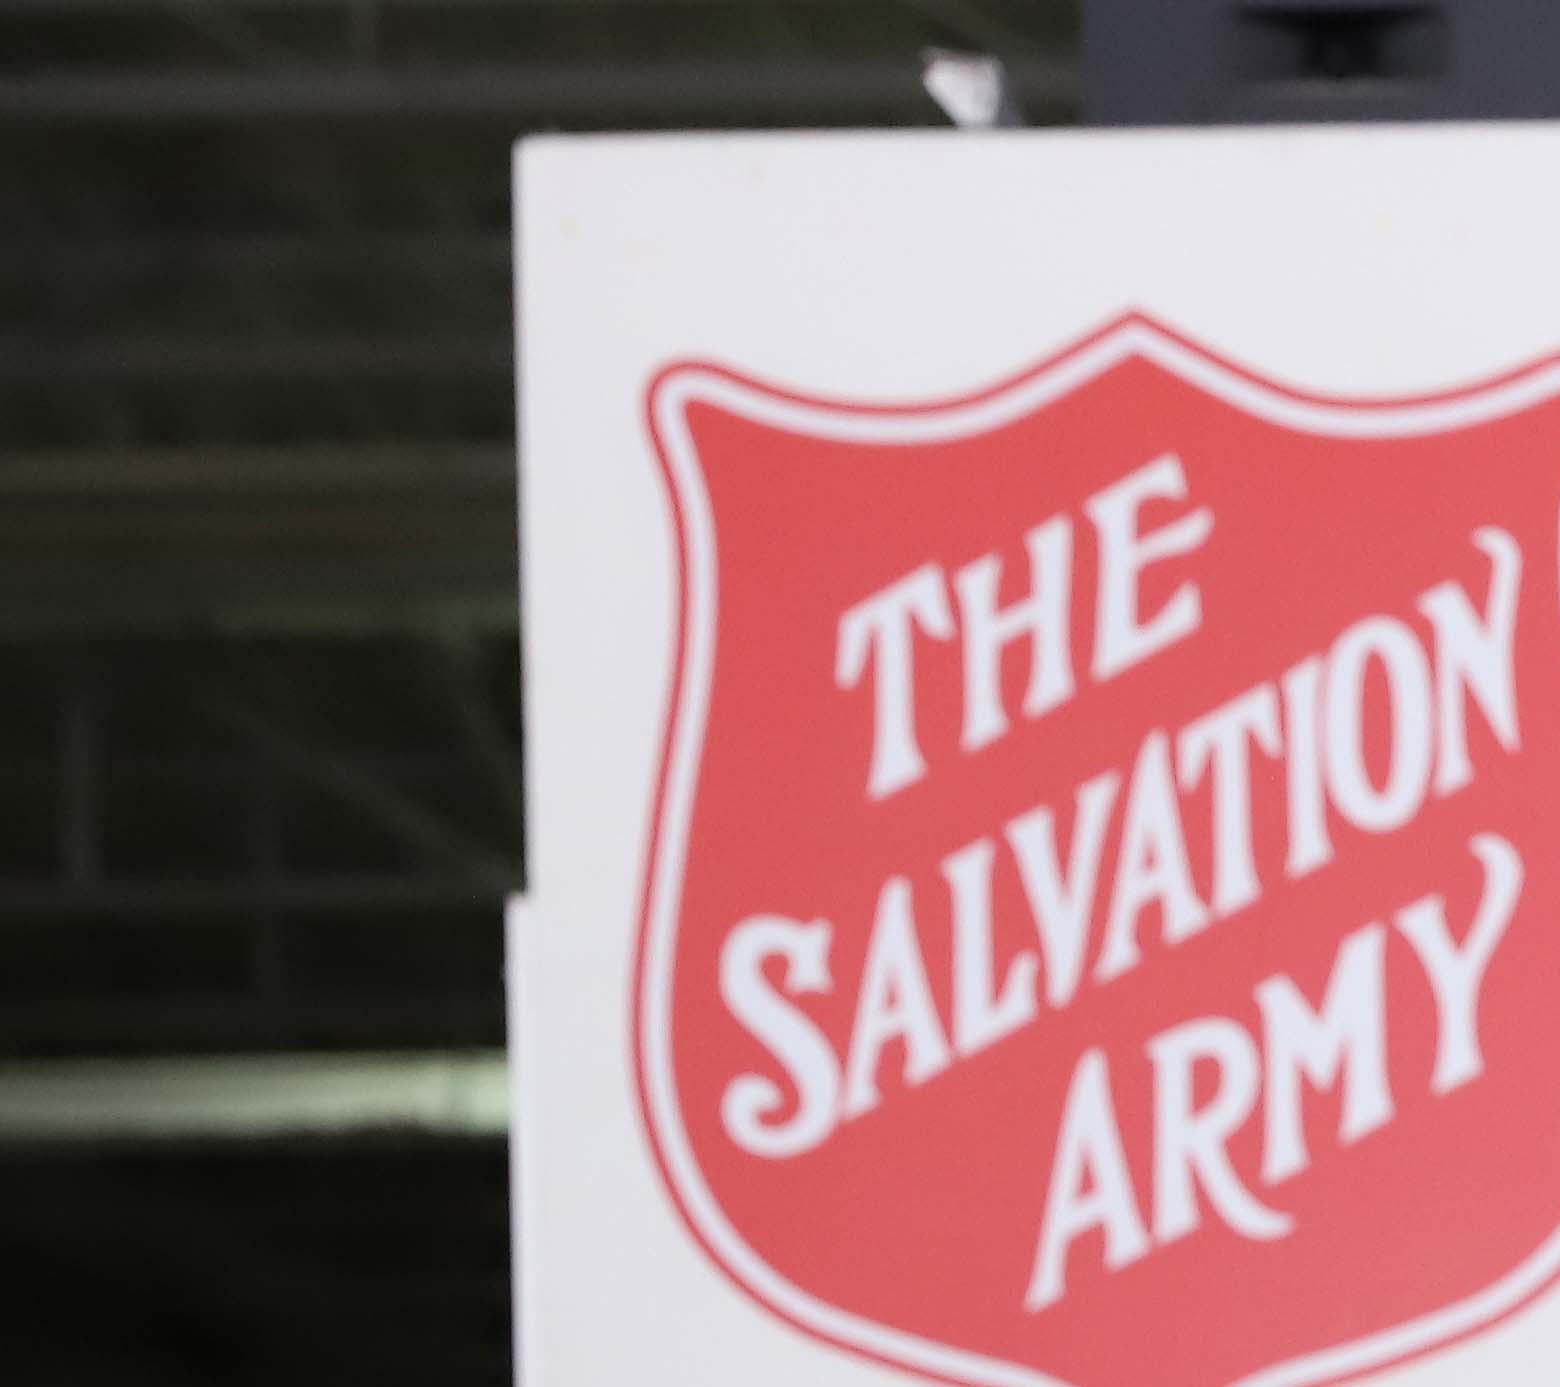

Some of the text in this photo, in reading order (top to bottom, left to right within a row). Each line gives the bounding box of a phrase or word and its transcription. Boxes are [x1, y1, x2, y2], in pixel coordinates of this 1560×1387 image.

[717, 523, 1524, 1160] SALVATION
[834, 450, 1216, 802] THE
[1021, 830, 1525, 1315] ARMY
